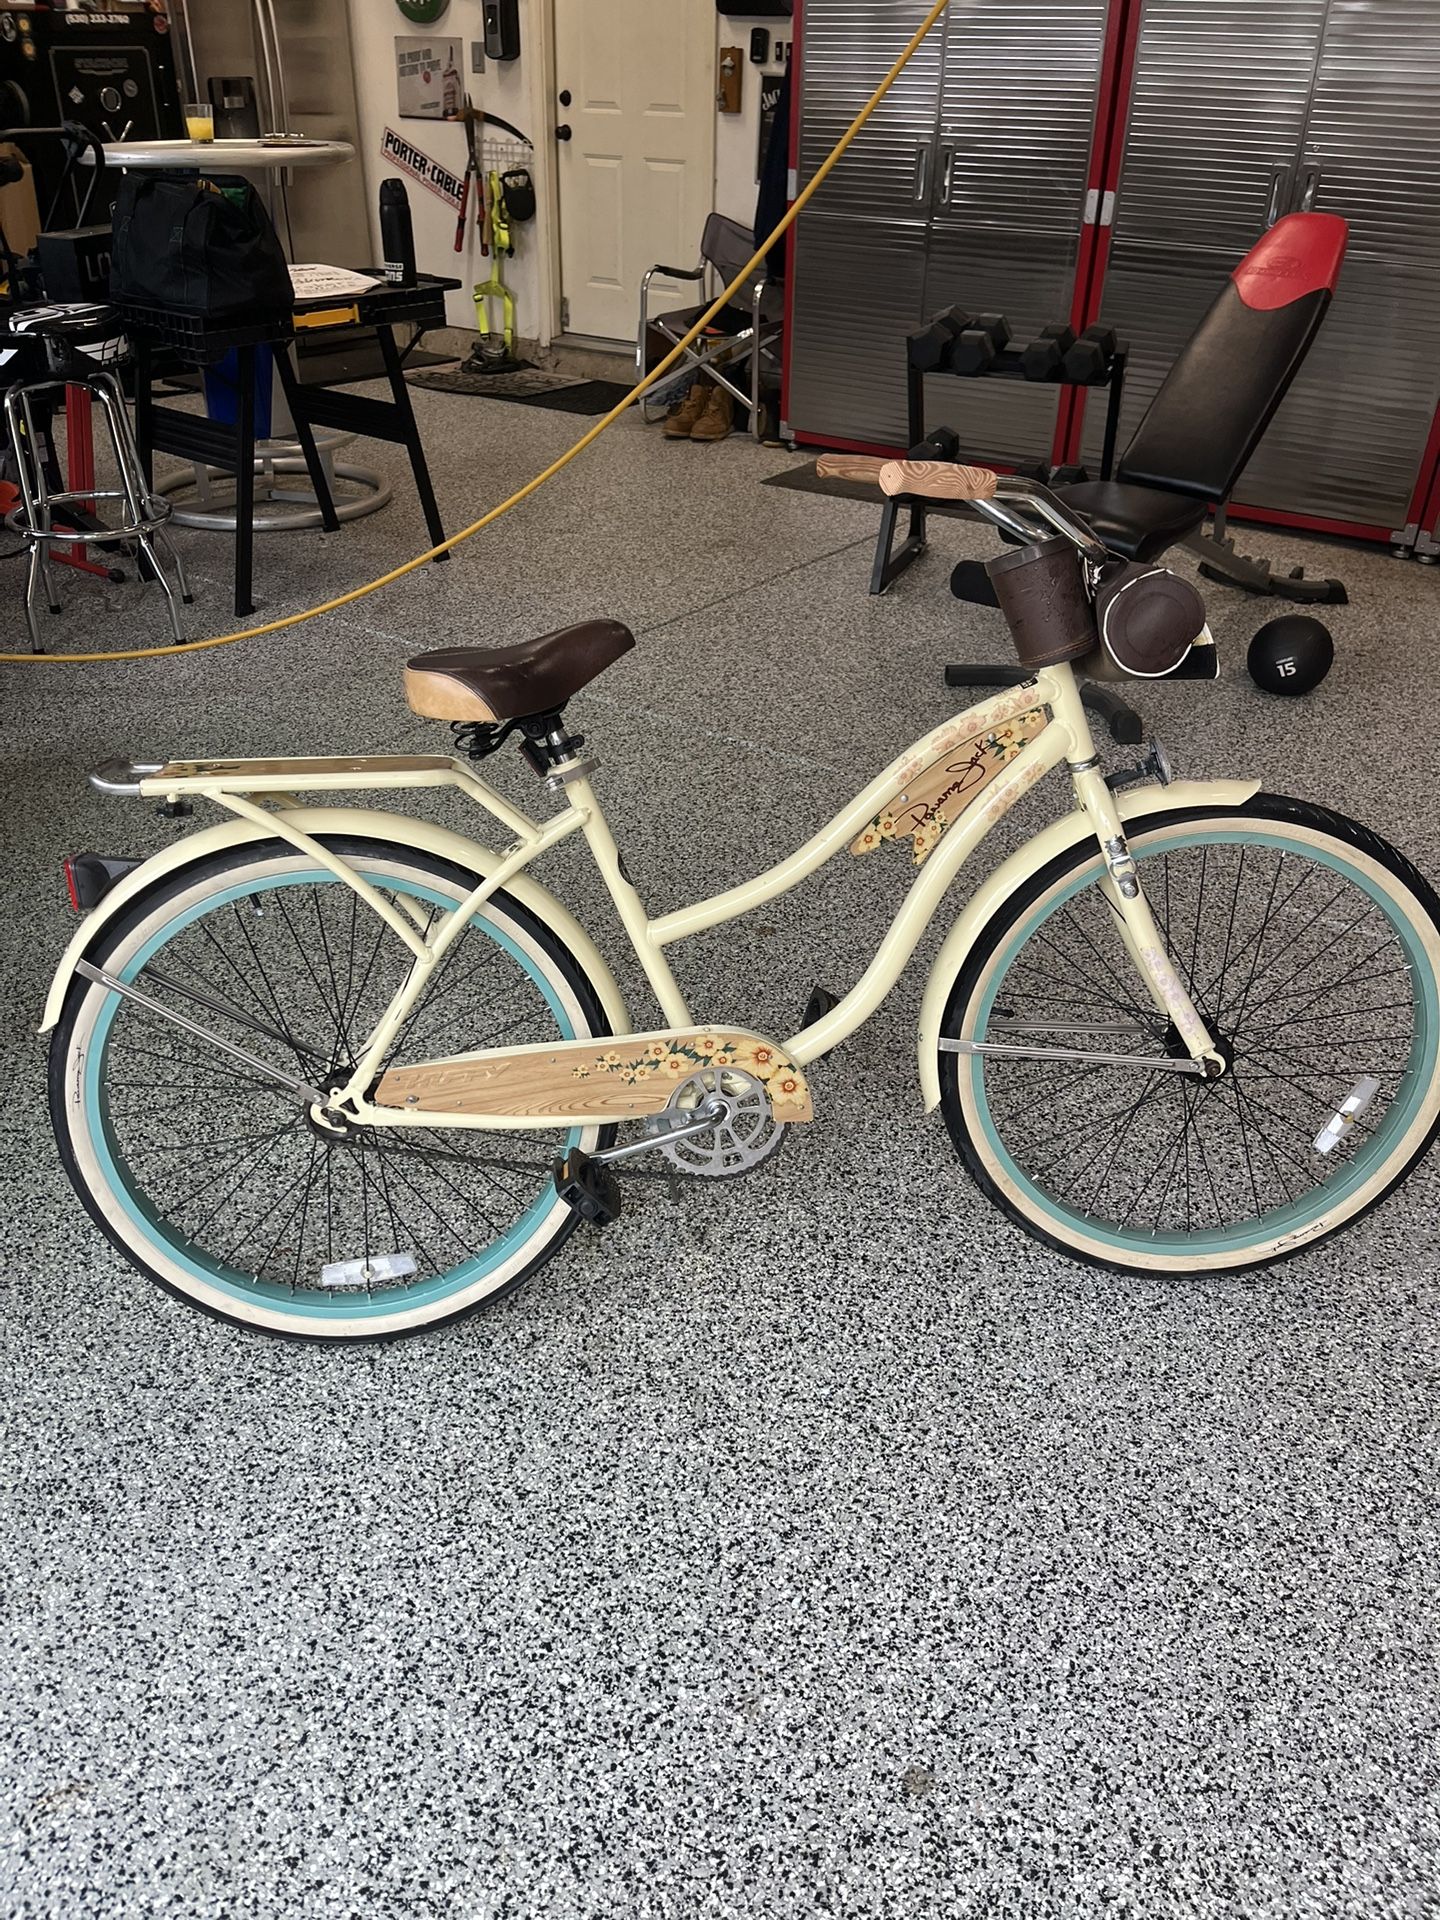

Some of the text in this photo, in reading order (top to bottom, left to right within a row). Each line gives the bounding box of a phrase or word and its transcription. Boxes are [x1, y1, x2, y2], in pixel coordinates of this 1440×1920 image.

[1276, 661, 1297, 678] 15
[894, 734, 1007, 833] Panama Jack
